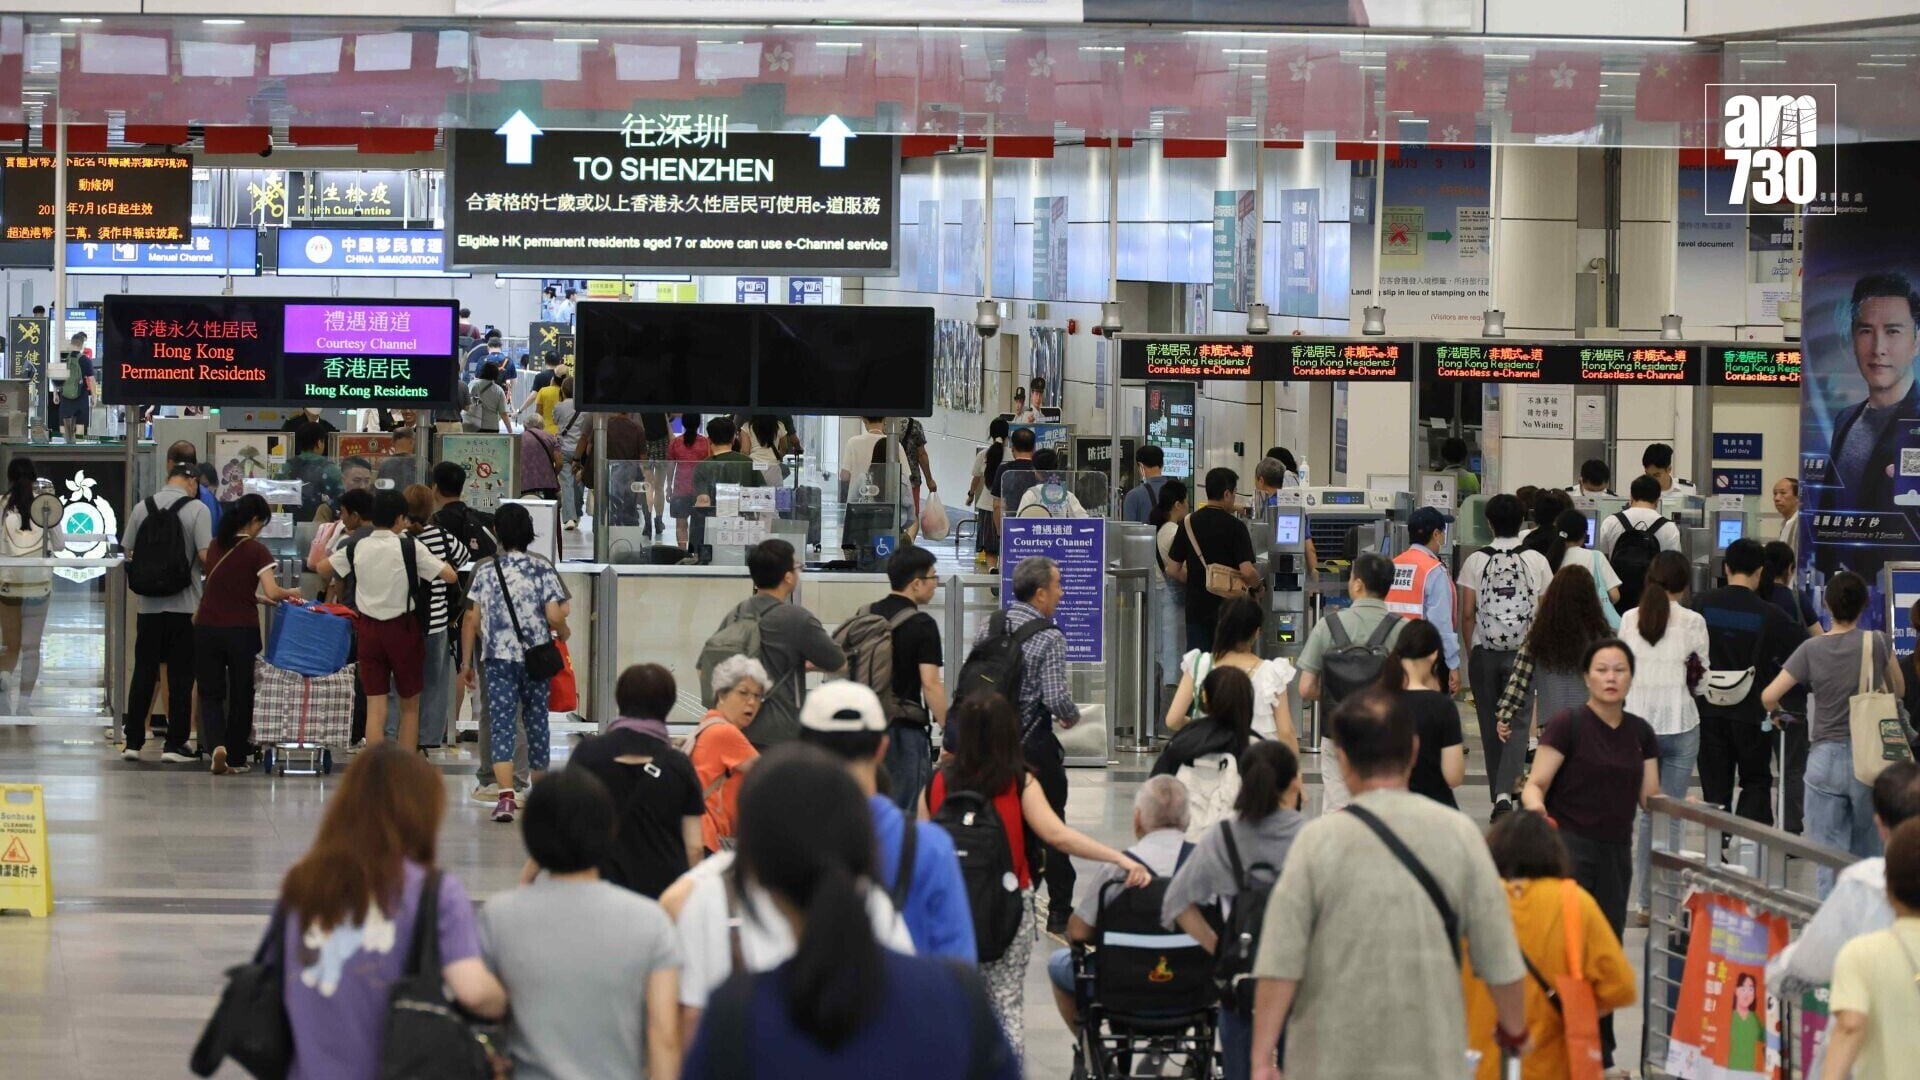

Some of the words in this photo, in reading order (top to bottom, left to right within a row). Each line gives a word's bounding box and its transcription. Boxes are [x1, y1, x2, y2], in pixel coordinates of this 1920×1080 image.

[620, 113, 728, 148] 往深圳
[573, 157, 613, 181] TO
[620, 157, 774, 182] SHENZHEN
[38, 202, 153, 215] 201年7月16日起生效
[297, 205, 330, 215] Hlth
[333, 206, 391, 215] Quantine
[457, 234, 500, 249] Eligible
[502, 235, 522, 247] HK
[523, 236, 586, 249] permanent
[588, 235, 640, 248] residents
[643, 236, 672, 250] aged
[675, 237, 682, 248] 7
[685, 239, 698, 248] or
[700, 237, 734, 249] above
[737, 239, 758, 249] can
[761, 239, 782, 249] use
[785, 238, 844, 250] e-Channel
[847, 238, 888, 250] service
[1697, 240, 1734, 248] document
[148, 253, 178, 262] Manual
[179, 253, 213, 262] Channel
[345, 255, 374, 264] CHINA
[379, 255, 439, 264] IMMIGRATION
[1351, 289, 1380, 297] Landi
[1383, 289, 1396, 297] slip
[1431, 290, 1465, 298] stamping
[324, 310, 411, 332] 禮遇通道
[131, 319, 258, 339] 香港永久性居民
[316, 337, 367, 351] Courtesy
[370, 338, 417, 350] Channel
[1146, 343, 1191, 356] 香港居民
[153, 343, 191, 361] Hong
[196, 343, 234, 361] Kong
[1291, 345, 1336, 358] 香港居民
[1436, 346, 1481, 359] 香港居民
[1580, 348, 1625, 361] 香港居民
[1724, 351, 1768, 363] 香港居民
[1147, 356, 1173, 365] Hong
[1175, 356, 1198, 366] Kong
[1200, 357, 1245, 365] Residents
[1292, 358, 1318, 367] Hong
[1320, 358, 1344, 368] Kong
[1346, 358, 1390, 367] Residents
[1437, 359, 1462, 368] Hong
[1464, 359, 1489, 369] Kong
[1490, 360, 1534, 369] Residents
[1581, 361, 1606, 371] Hong
[1608, 361, 1632, 371] Kong
[1634, 361, 1678, 370] Residents
[121, 363, 195, 380] Permanent
[198, 365, 266, 381] Residents
[323, 357, 411, 380] 香港居民
[1148, 364, 1200, 374] Contactless
[1203, 365, 1251, 374] e-Channel
[1293, 366, 1346, 376] Contactless
[1348, 367, 1396, 376] e-Channel
[1438, 367, 1490, 377] Contactless
[1493, 368, 1540, 378] e-Channel
[1725, 362, 1749, 373] Hong
[1752, 362, 1775, 374] Kong
[1582, 370, 1635, 379] Contactless
[1636, 370, 1684, 379] e-Channel
[1725, 371, 1777, 381] Contactless
[304, 383, 336, 398] Hong
[339, 384, 371, 399] Kong
[374, 384, 429, 397] Residents
[1534, 421, 1564, 430] Waiting
[1013, 537, 1053, 548] Courtesy
[1055, 537, 1093, 547] Channel
